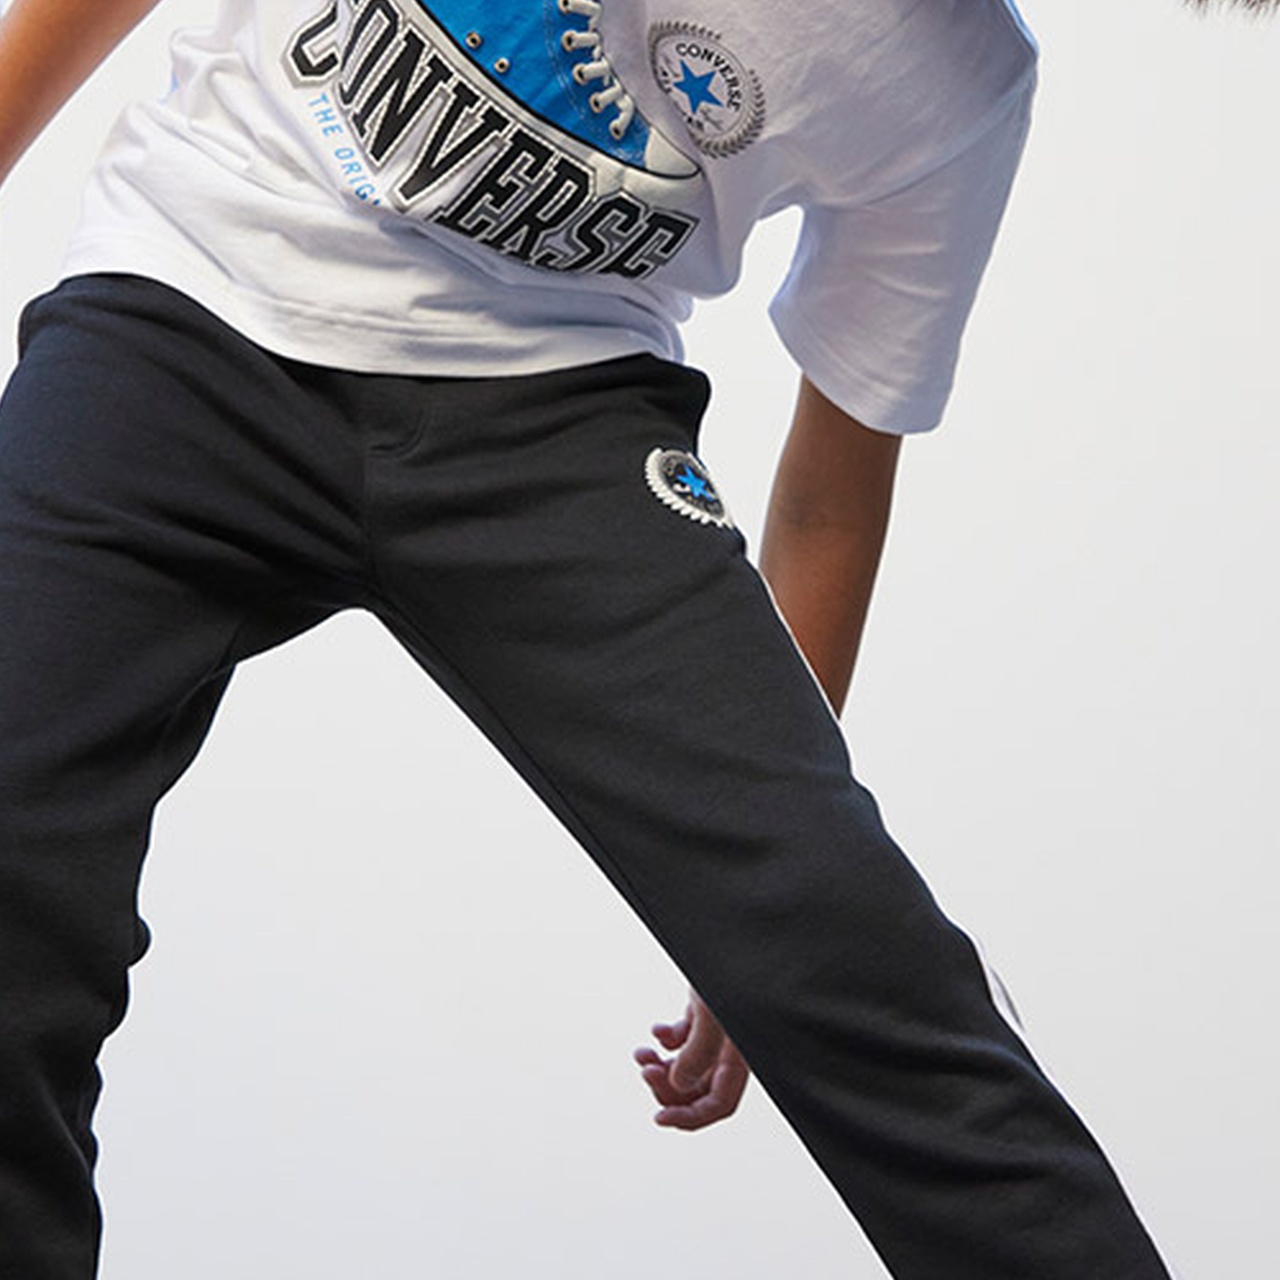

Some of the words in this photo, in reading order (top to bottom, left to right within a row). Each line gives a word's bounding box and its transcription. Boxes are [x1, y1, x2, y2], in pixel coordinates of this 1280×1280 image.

[675, 43, 741, 112] CONVERSE
[308, 93, 344, 138] THE
[334, 147, 381, 206] ORIG
